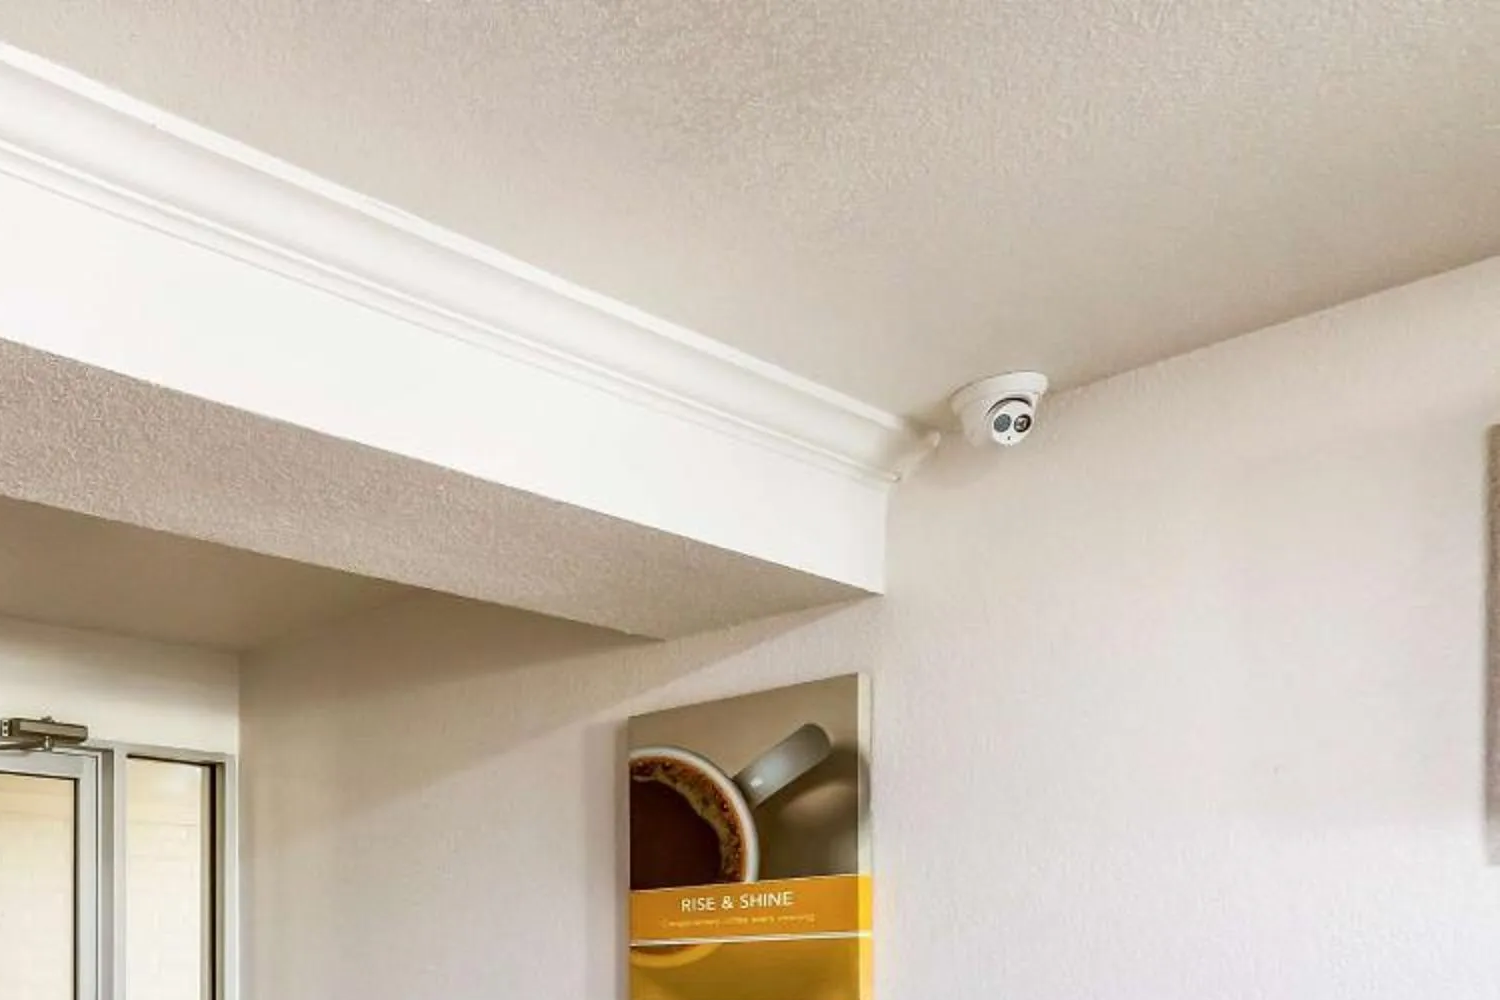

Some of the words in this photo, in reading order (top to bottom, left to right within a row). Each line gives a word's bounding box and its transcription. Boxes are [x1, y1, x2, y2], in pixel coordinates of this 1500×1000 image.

[680, 897, 716, 913] RISE
[720, 895, 735, 910] &
[739, 890, 794, 909] SHINE
